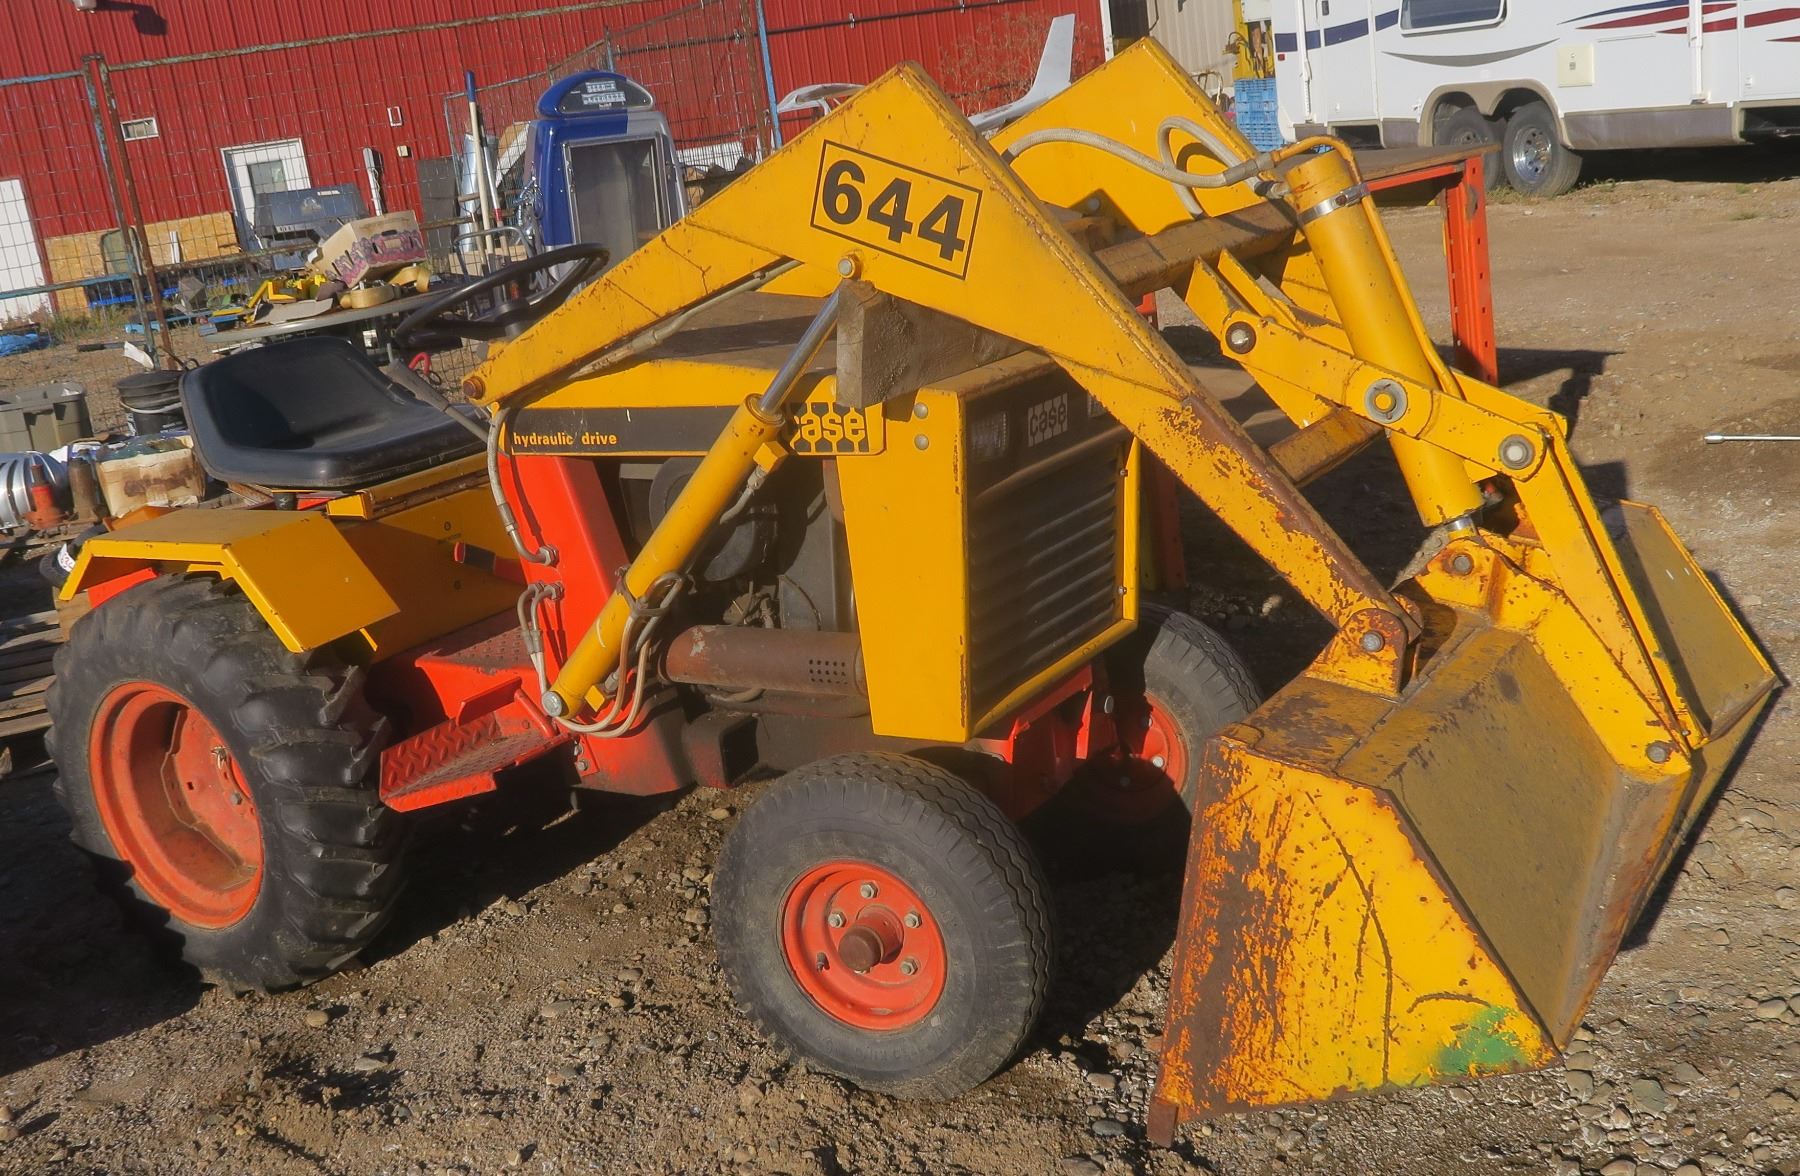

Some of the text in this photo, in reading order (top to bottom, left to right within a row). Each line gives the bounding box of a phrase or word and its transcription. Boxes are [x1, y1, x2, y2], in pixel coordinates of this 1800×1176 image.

[822, 159, 966, 262] 644
[1029, 402, 1068, 438] case
[512, 431, 617, 448] hydraulic drive
